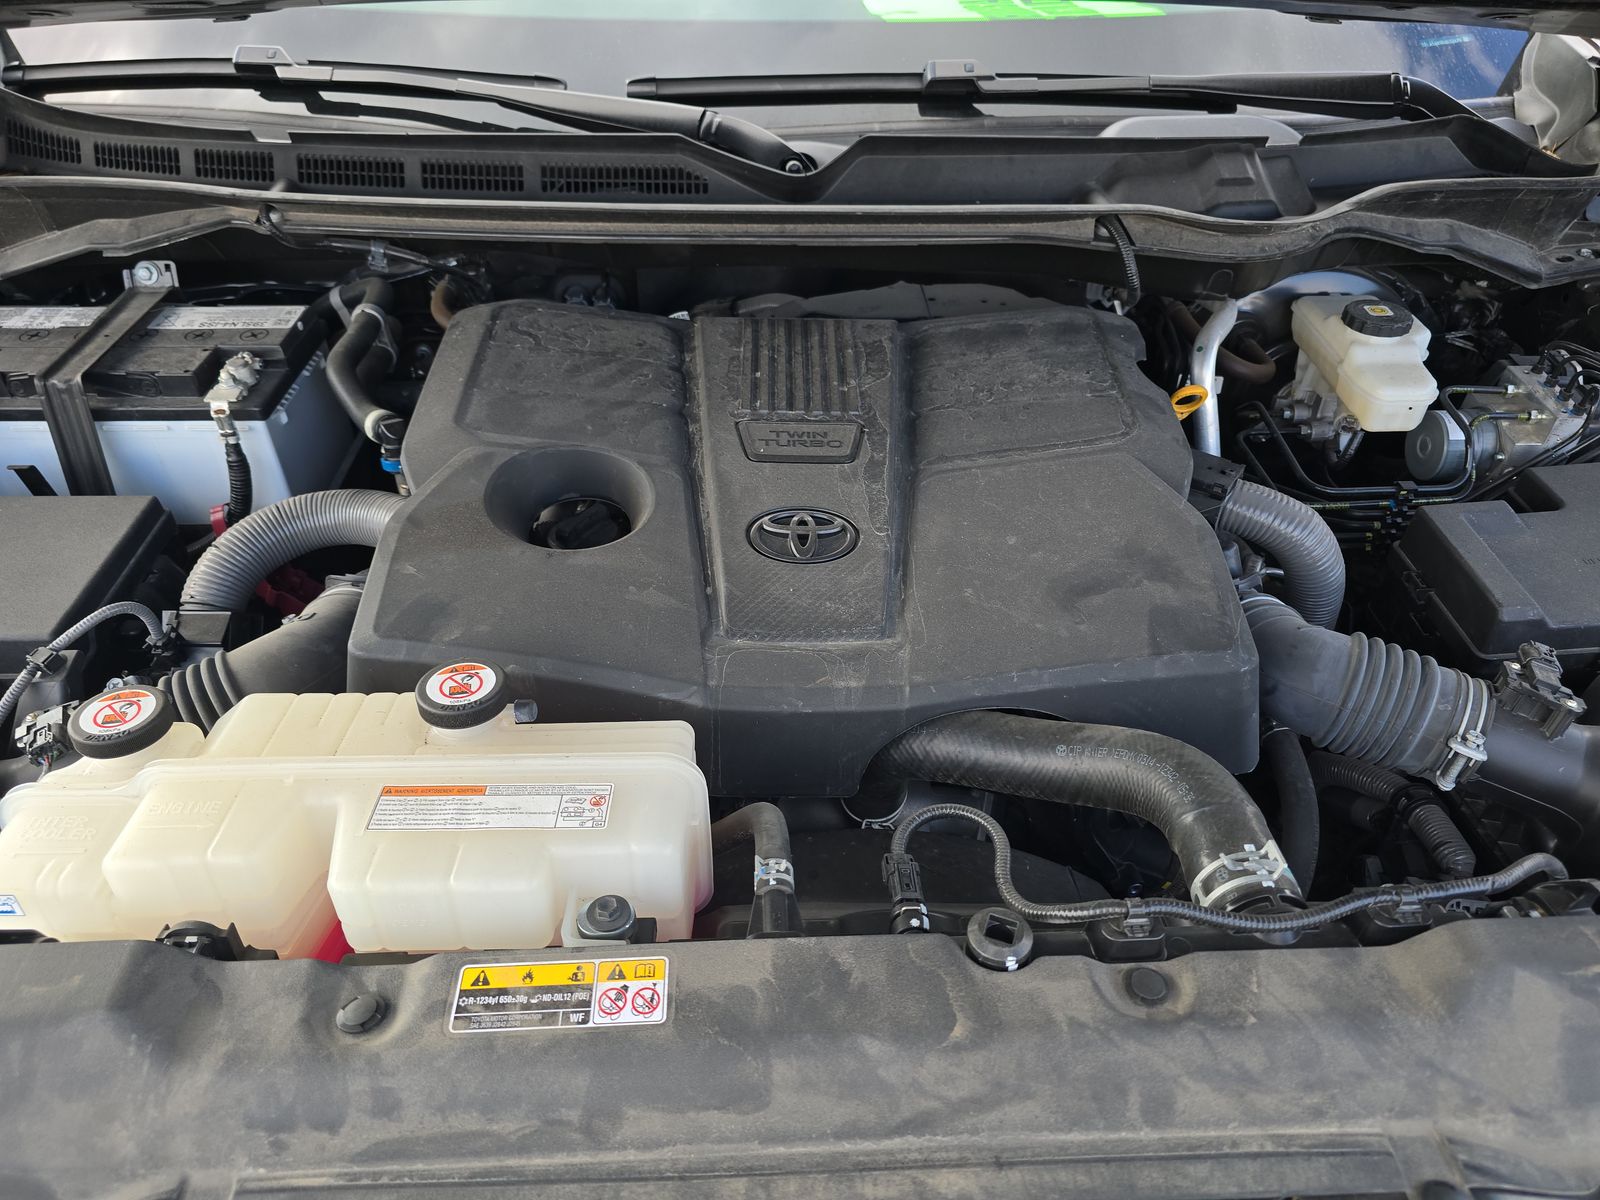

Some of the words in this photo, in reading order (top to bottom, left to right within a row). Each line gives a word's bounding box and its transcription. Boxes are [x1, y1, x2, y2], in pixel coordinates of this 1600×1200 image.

[769, 430, 828, 439] TWIN
[757, 438, 843, 448] TURBO
[147, 800, 222, 815] ENGINE
[28, 816, 89, 827] INTER
[17, 827, 97, 841] COOLER
[468, 996, 498, 1005] R-1234yf
[569, 1012, 585, 1023] WF
